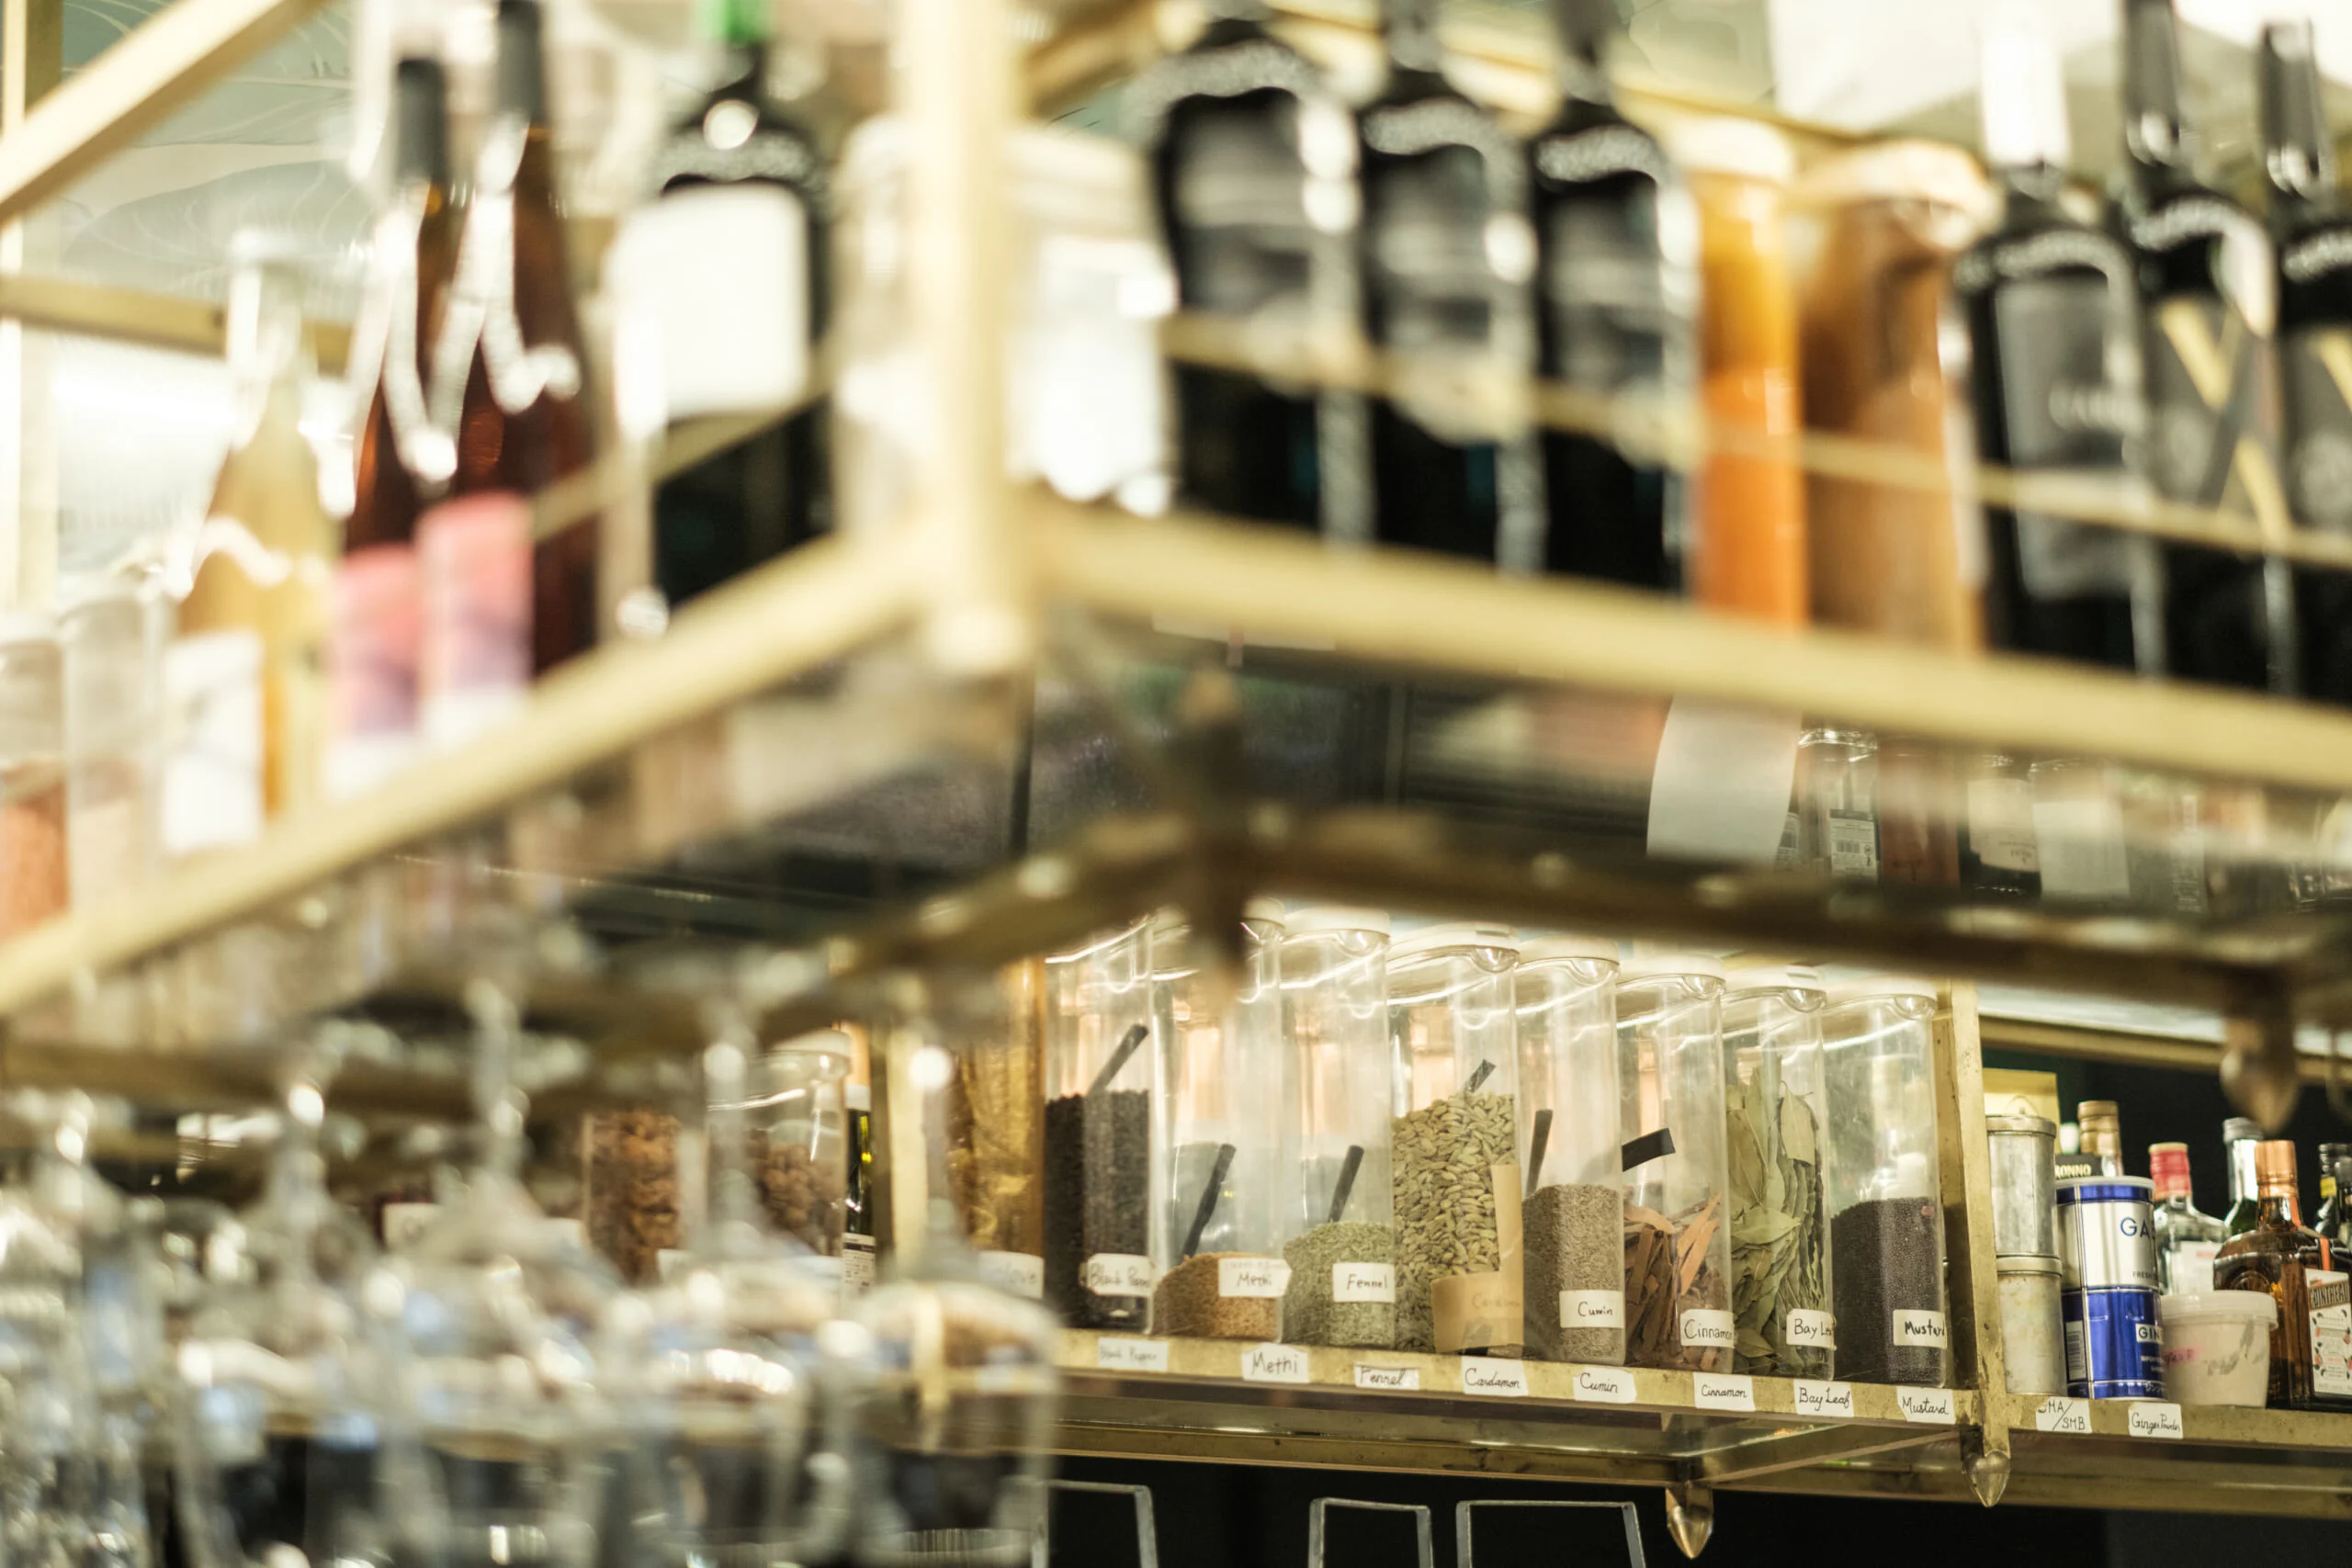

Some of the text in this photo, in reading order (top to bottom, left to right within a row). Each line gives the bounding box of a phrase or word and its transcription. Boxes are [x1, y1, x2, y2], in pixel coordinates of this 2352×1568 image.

[1236, 1271, 1272, 1287] Methi
[1346, 1273, 1388, 1291] Fennel
[1577, 1301, 1613, 1317] Cumin
[1794, 1318, 1817, 1339] Bay
[1251, 1351, 1298, 1377] Methi
[1360, 1365, 1407, 1386] Fennel
[1579, 1371, 1618, 1393] Cumin
[1701, 1383, 1747, 1398] Cinnamon
[1799, 1386, 1851, 1412] Bay Leaf
[1902, 1395, 1950, 1416] Mustard
[2132, 1411, 2159, 1435] Ginger
